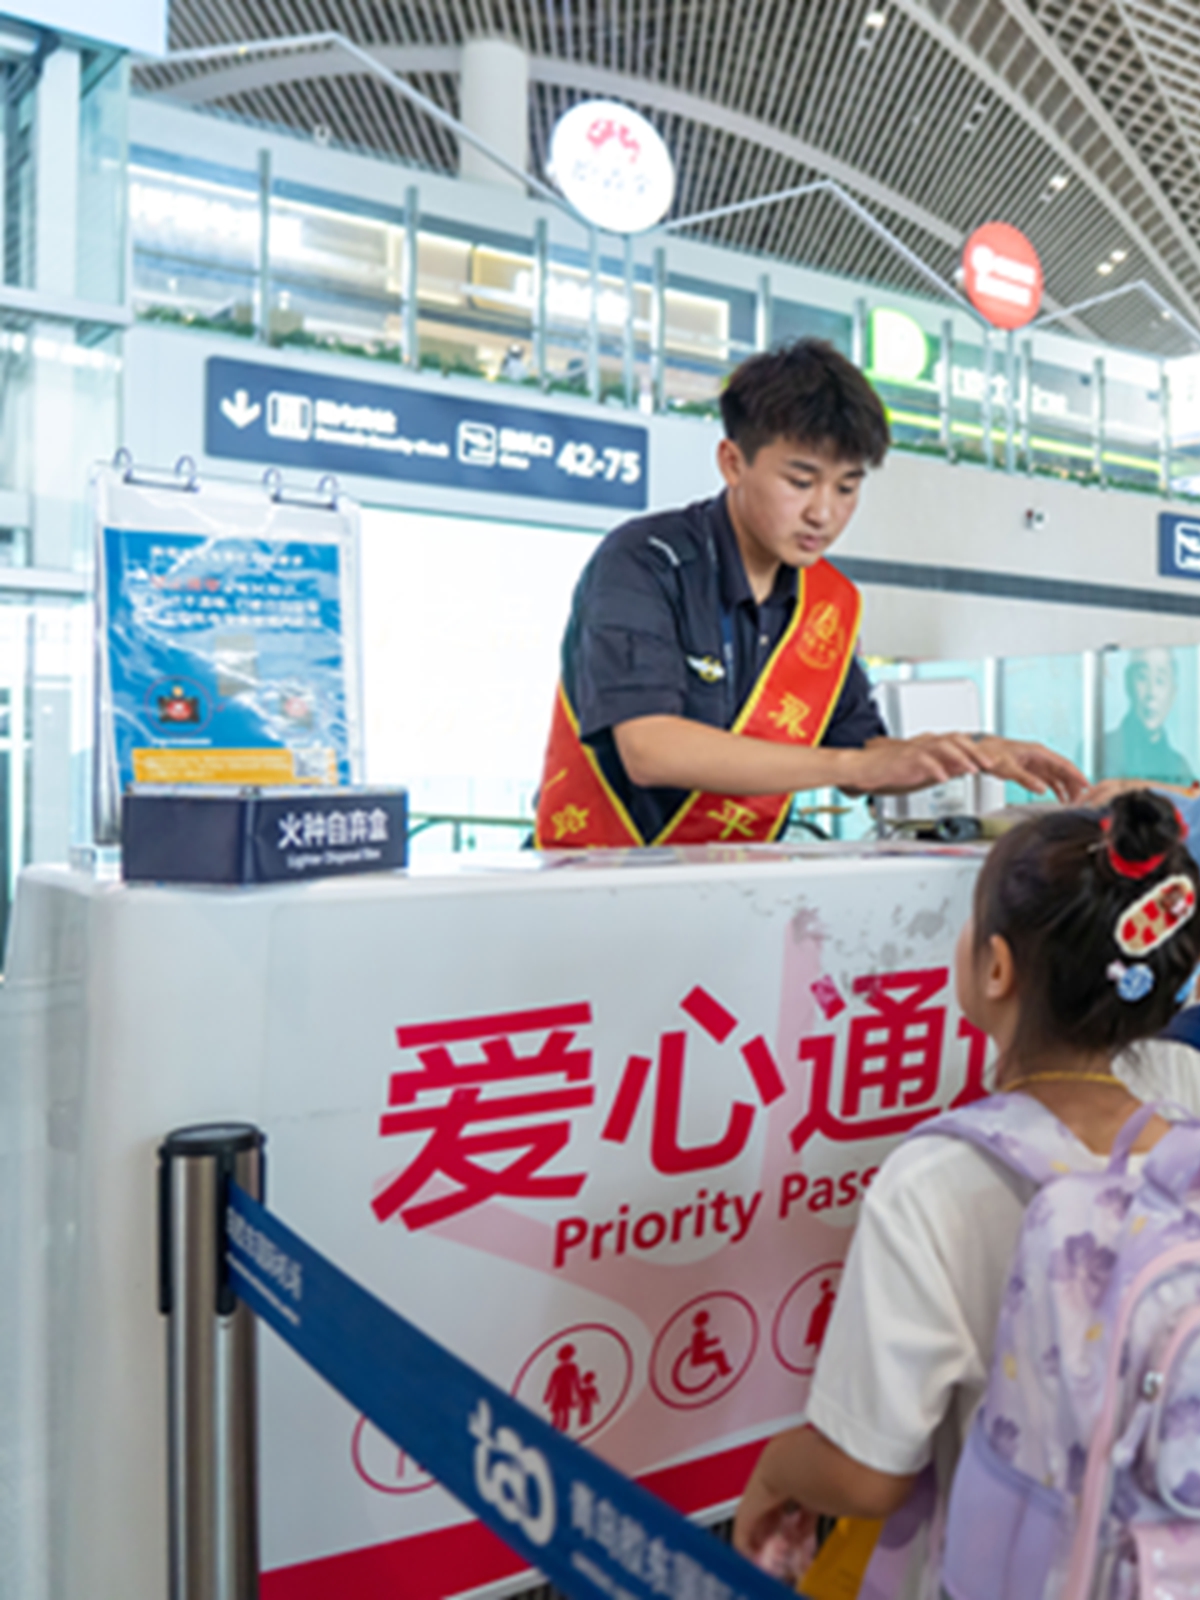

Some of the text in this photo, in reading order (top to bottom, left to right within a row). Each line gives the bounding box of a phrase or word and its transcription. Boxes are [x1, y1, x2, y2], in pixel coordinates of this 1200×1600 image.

[557, 443, 640, 482] 42-75
[278, 807, 389, 850] 火种自弃盒
[552, 1190, 762, 1269] Priority
